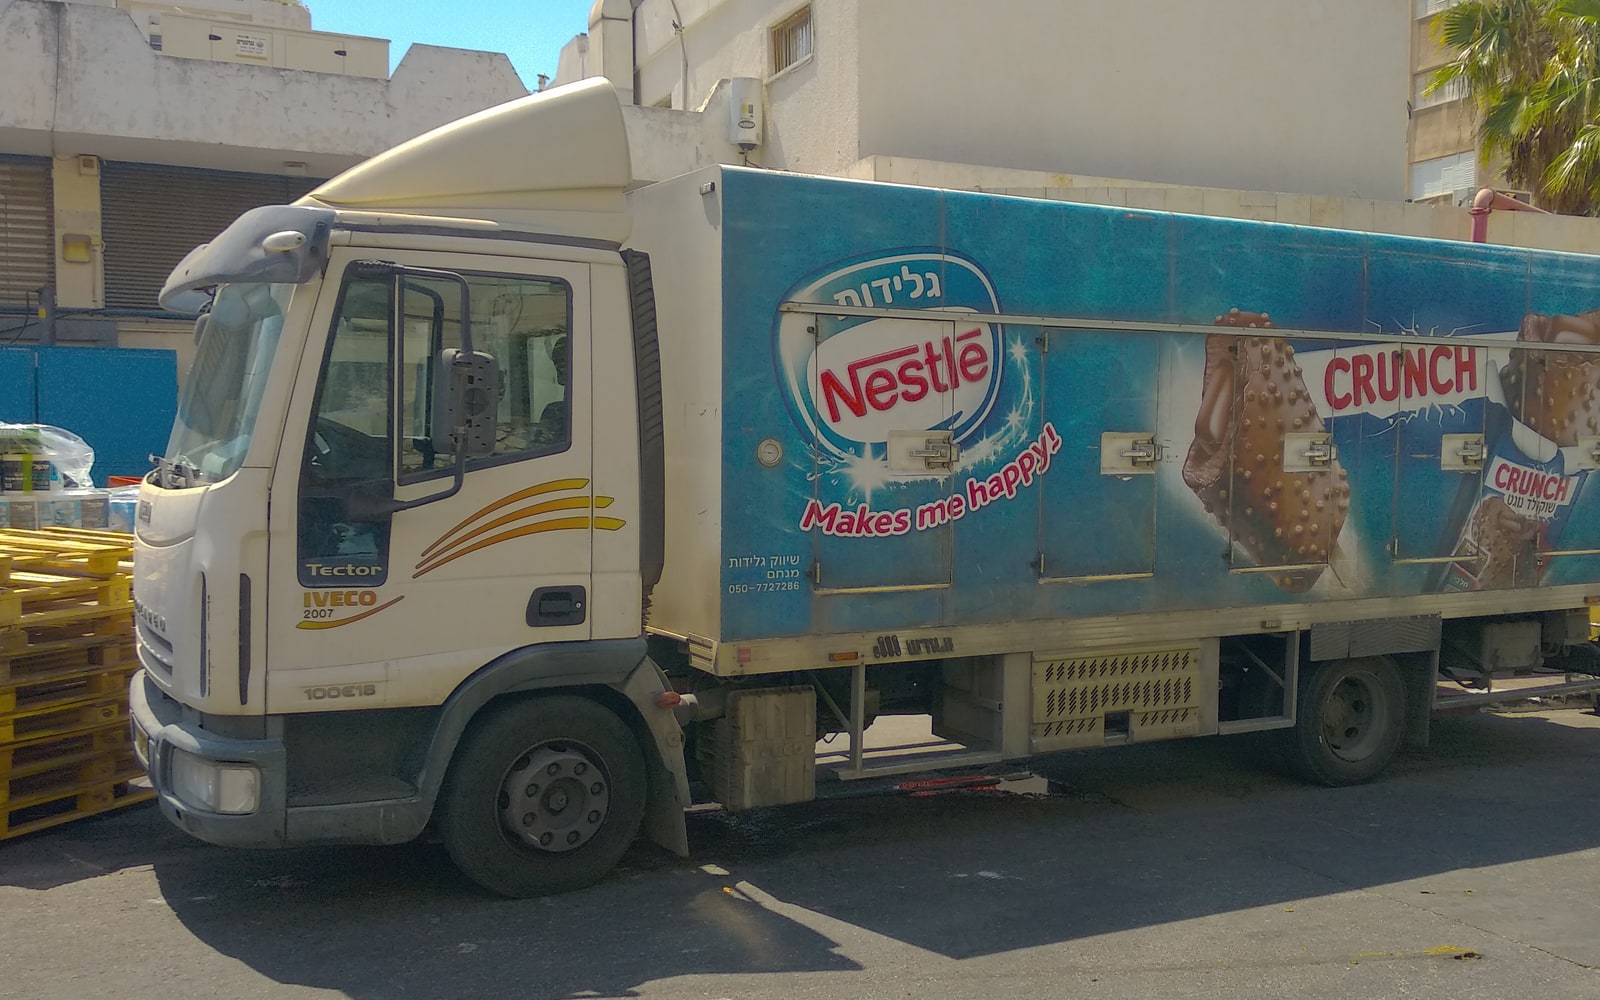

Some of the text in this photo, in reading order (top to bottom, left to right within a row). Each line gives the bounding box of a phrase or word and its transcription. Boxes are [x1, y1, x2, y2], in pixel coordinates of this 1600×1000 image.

[833, 265, 942, 320] גלידות
[820, 327, 989, 424] Nestlé
[1324, 345, 1478, 411] CRUNCH
[801, 424, 1061, 536] Makes me happy!
[1494, 463, 1571, 502] CRUNCH
[305, 563, 382, 577] Tector
[728, 554, 800, 569] שיווק גלידות
[766, 568, 800, 579] מנחם
[728, 581, 800, 594] 050-7727286
[303, 590, 377, 608] IVECO
[303, 608, 334, 619] 2007
